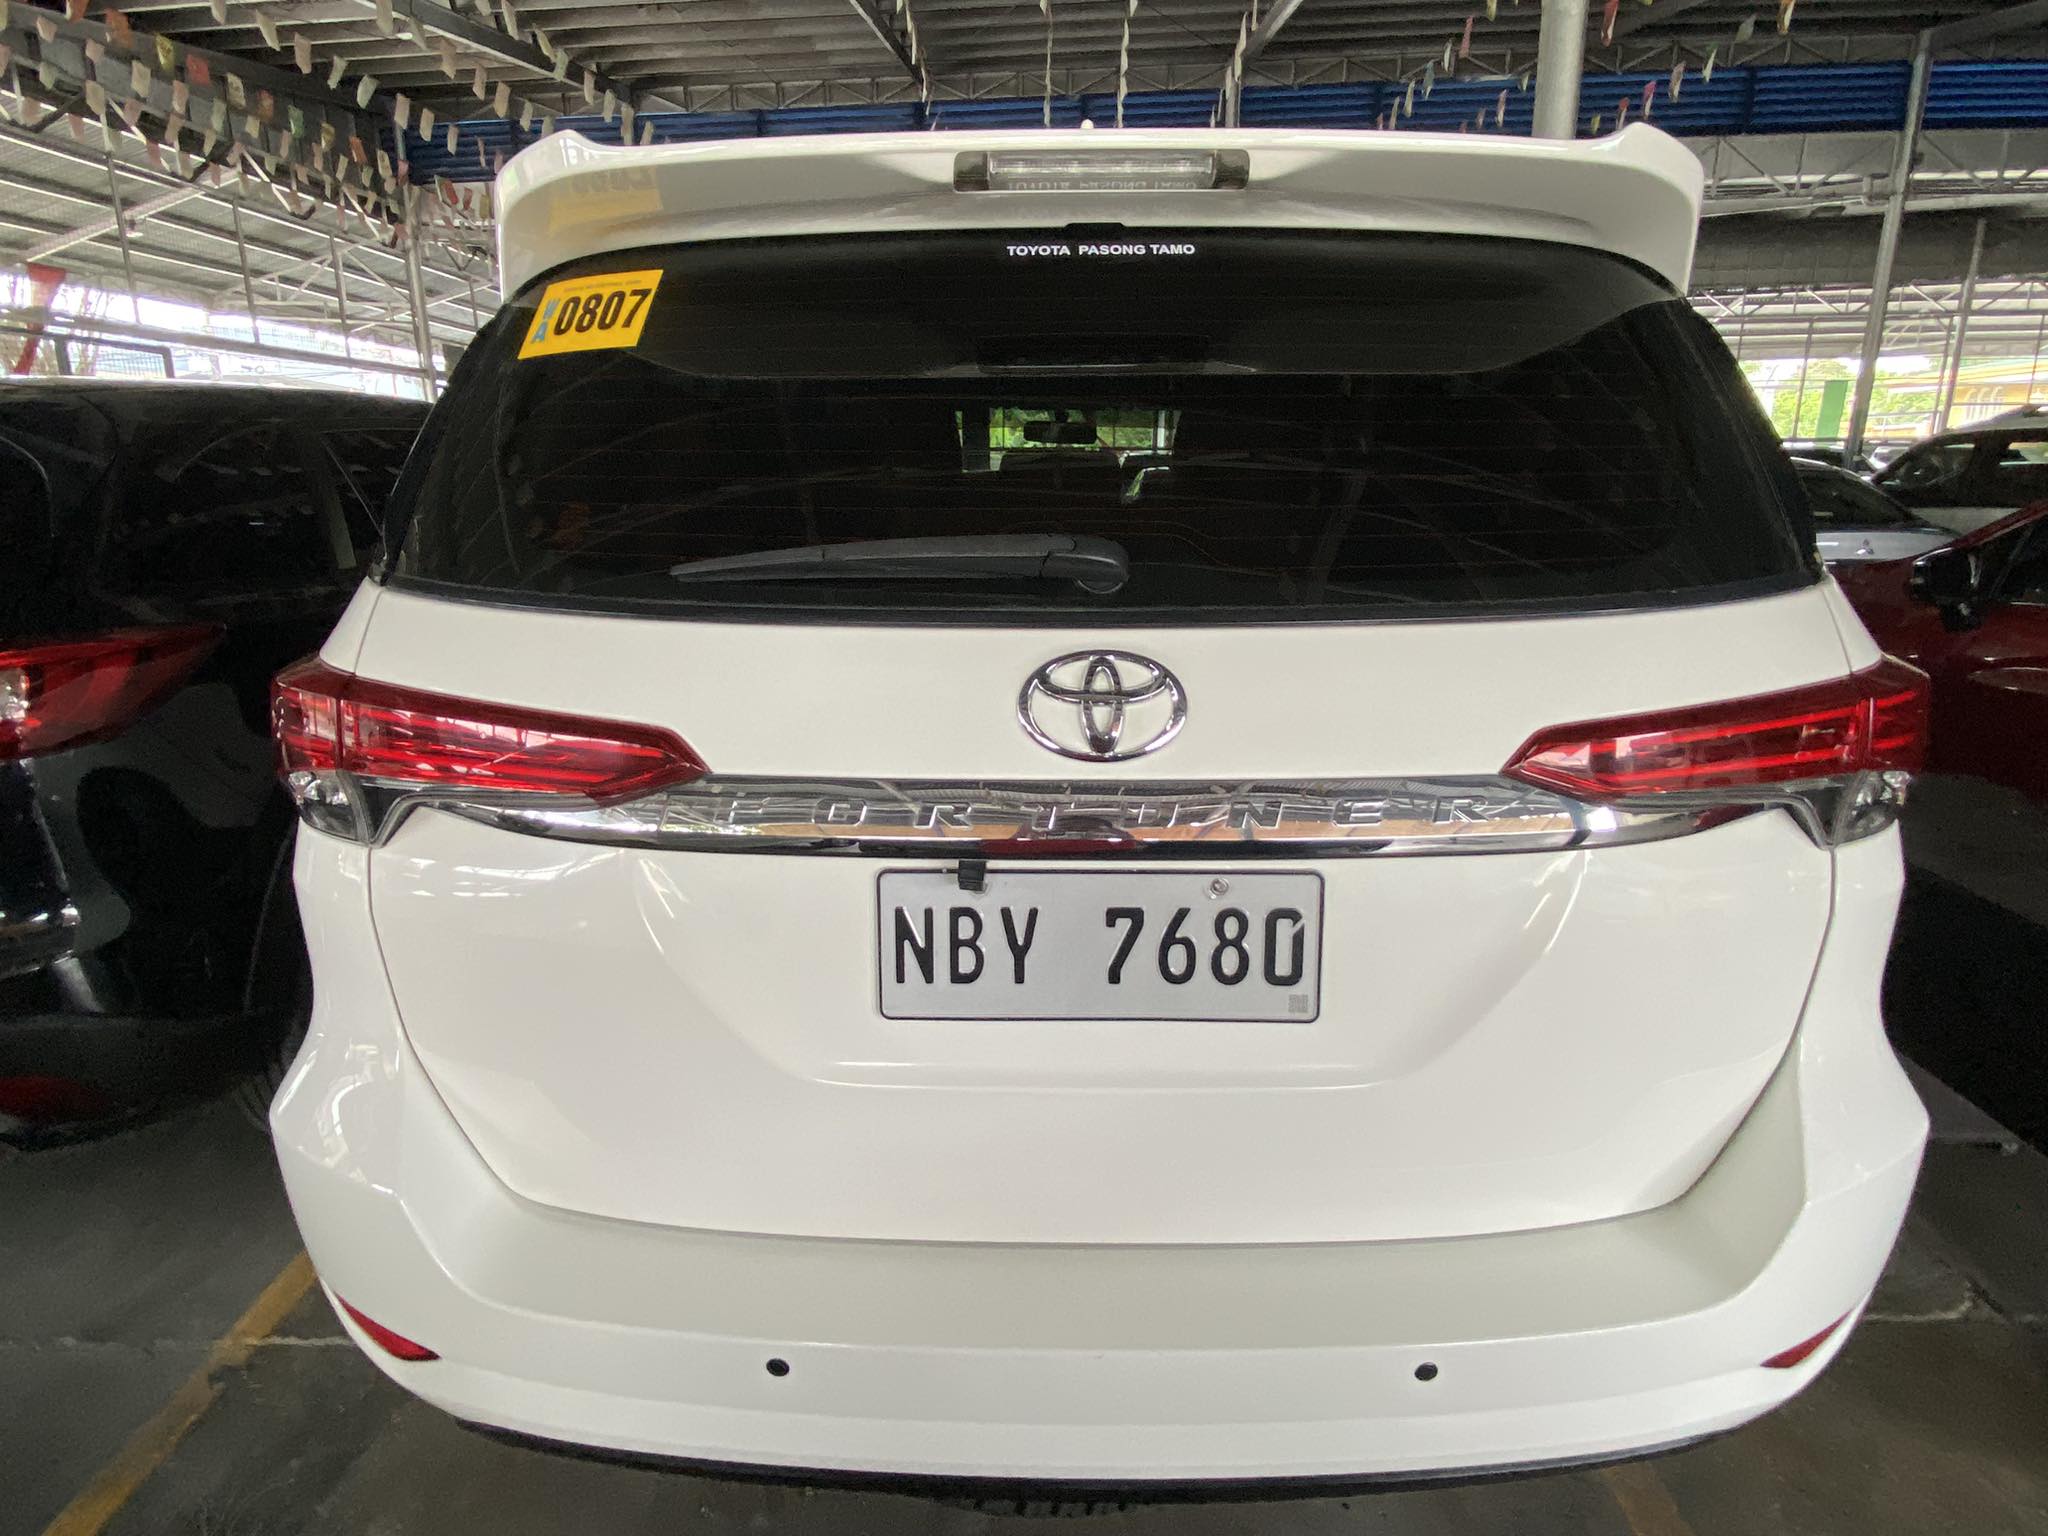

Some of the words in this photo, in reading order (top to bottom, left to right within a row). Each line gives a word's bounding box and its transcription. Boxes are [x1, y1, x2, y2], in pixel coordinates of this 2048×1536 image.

[1007, 245, 1071, 256] TOYOTA
[1078, 244, 1146, 255] PASONG
[1149, 244, 1196, 255] TAMO
[553, 288, 652, 336] 0807
[712, 797, 1490, 830] FORTUNER
[895, 906, 1039, 984] NBY
[1105, 907, 1306, 986] 7680
